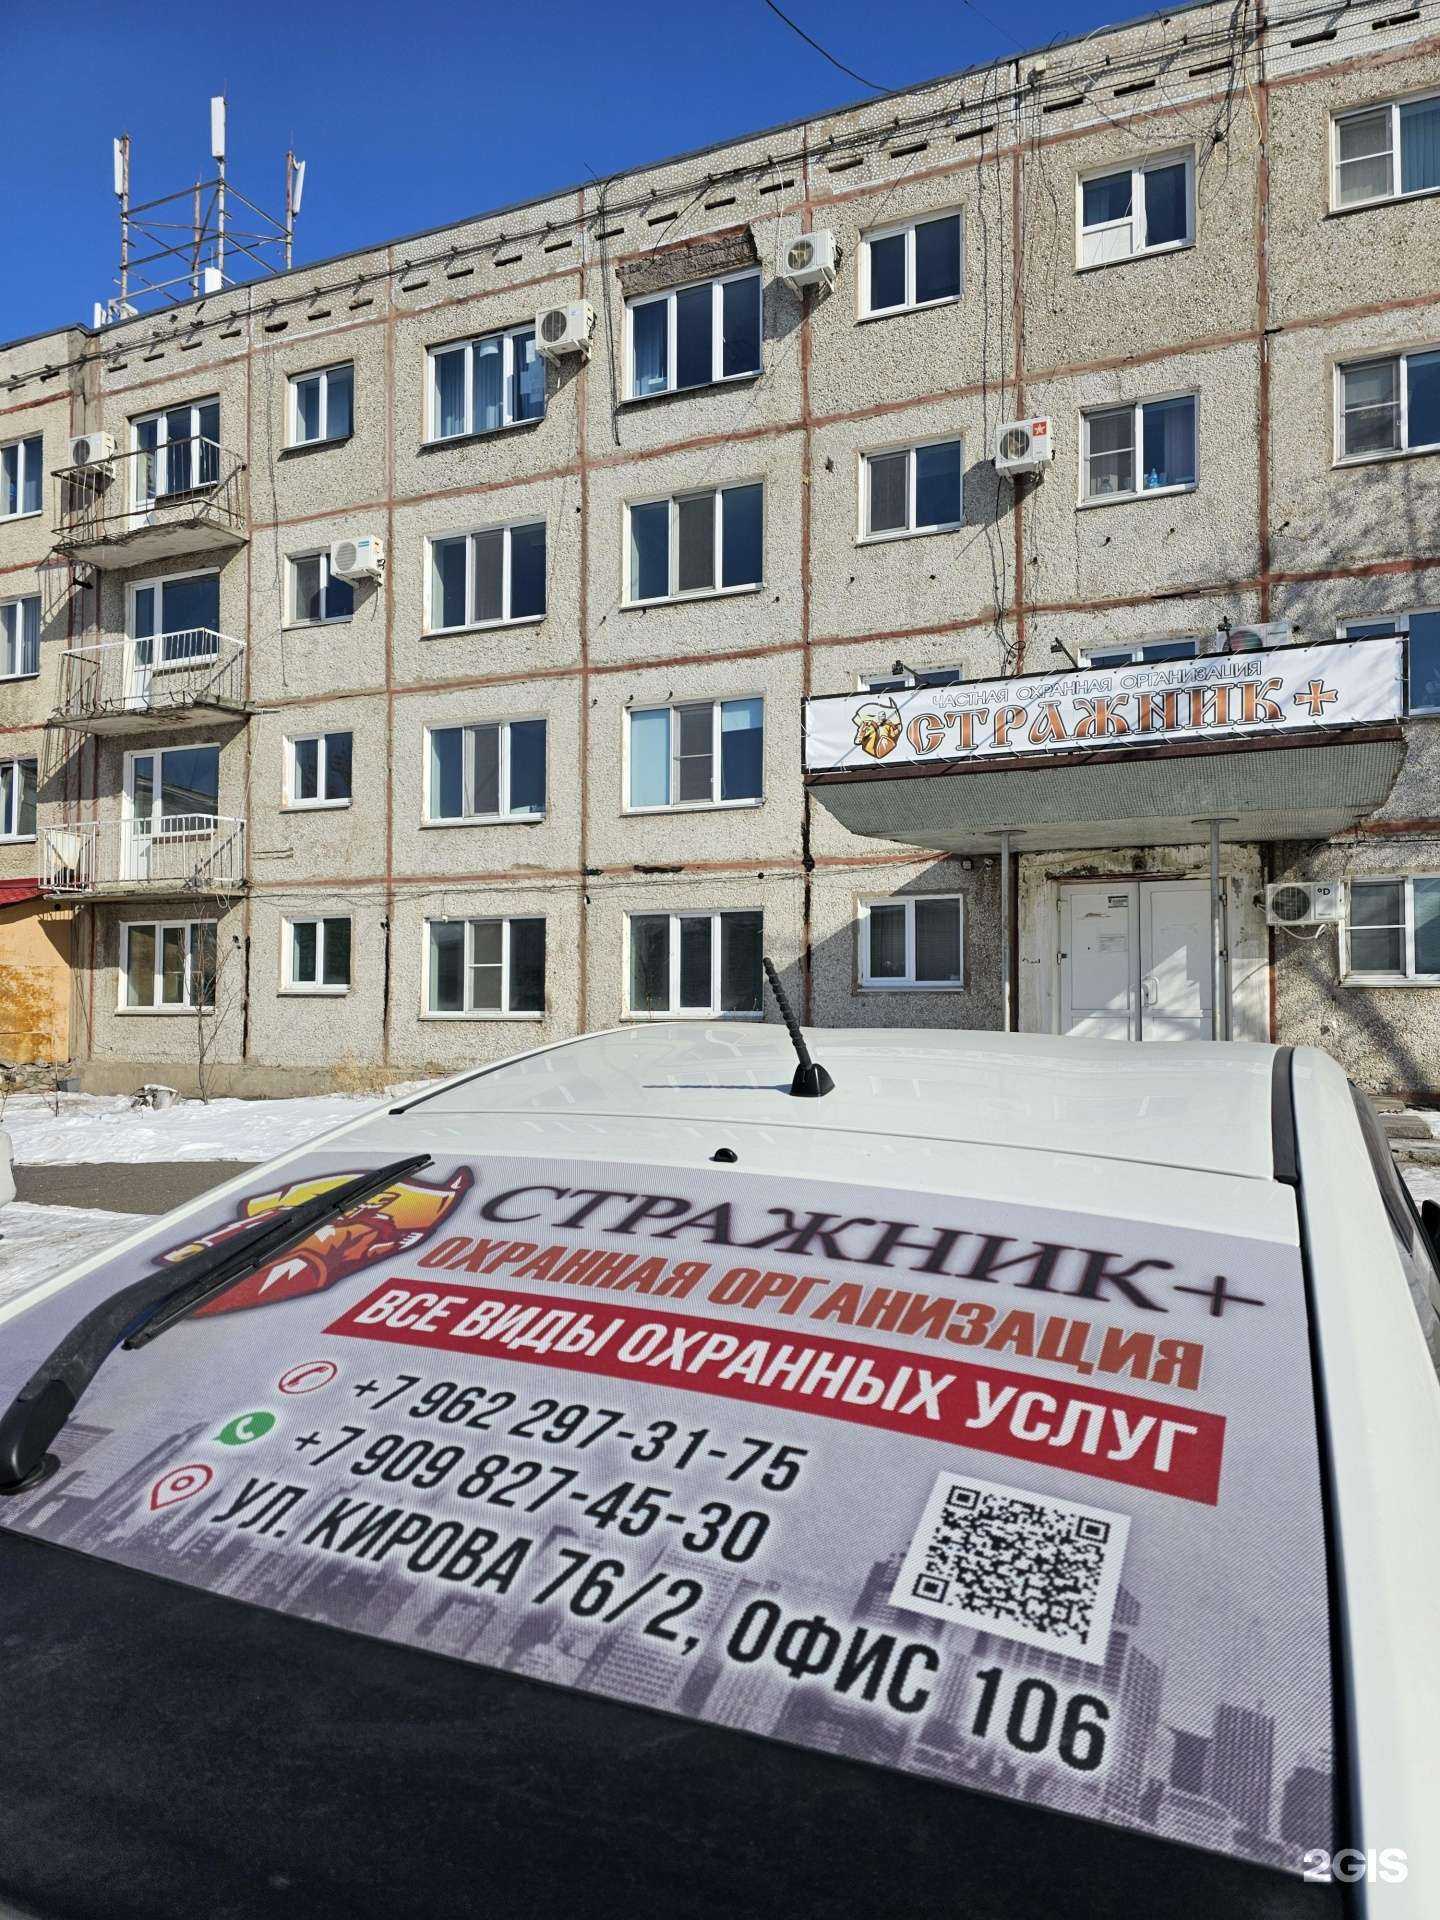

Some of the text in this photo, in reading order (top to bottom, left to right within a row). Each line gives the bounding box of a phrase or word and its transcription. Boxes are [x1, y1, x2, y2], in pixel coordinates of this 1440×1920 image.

[932, 660, 1262, 708] ЧАСТНАЯ ОХРАННАЯ ОРГАНИЗАЦИЯ
[352, 1288, 1199, 1473] ВСЕ ВИДЫ ОХРАННЫХ УСЛУГ
[417, 1236, 1204, 1391] ОХРАННАЯ ОРГАНИЗАЦИЯ
[294, 1426, 771, 1564] +7 909 827-45-30
[354, 1376, 808, 1492] +7 962 297-31-75
[210, 1478, 1111, 1772] УЛ. КИРОВА 76/2, ОФИС 106
